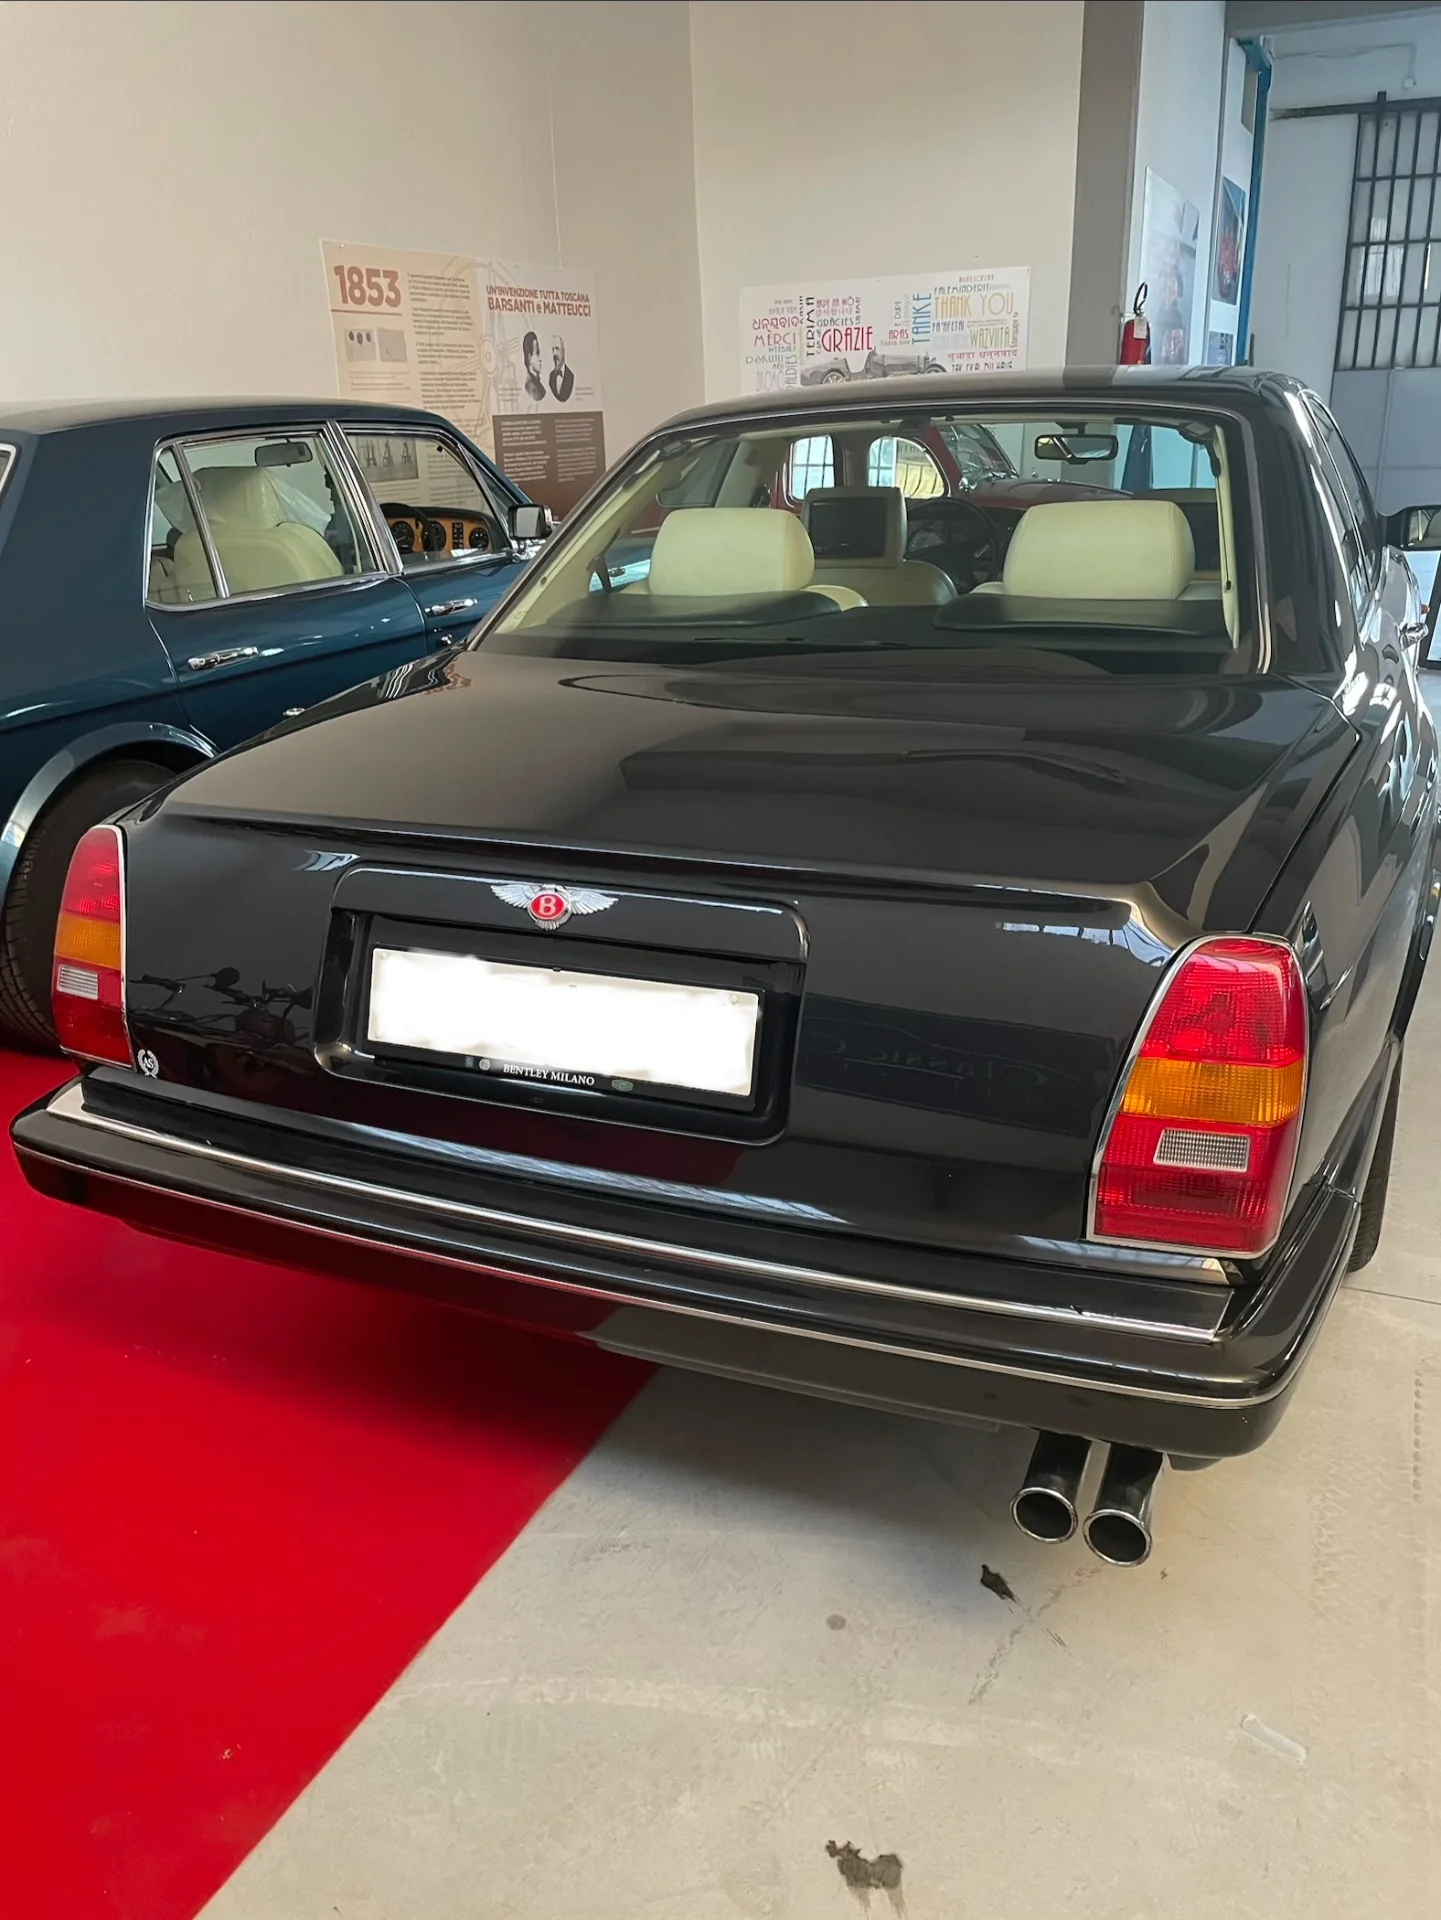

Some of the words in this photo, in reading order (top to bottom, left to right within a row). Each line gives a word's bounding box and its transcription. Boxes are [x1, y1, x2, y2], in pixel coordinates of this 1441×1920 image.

[333, 265, 402, 308] 1853
[486, 284, 539, 299] UN'INVENZIONE
[539, 289, 559, 300] TUTTA
[561, 291, 590, 303] TOSCANA
[487, 297, 535, 314] BARSANTI
[536, 303, 542, 314] e
[543, 301, 591, 317] MATTEUCCI
[934, 295, 972, 319] THANK
[980, 292, 1014, 316] YOU
[805, 296, 815, 357] TERIMA
[754, 332, 796, 347] MERCI
[821, 326, 873, 352] GRAZIE
[538, 895, 557, 916] B
[503, 1063, 549, 1079] BENTLEY
[550, 1071, 595, 1086] MILANO
